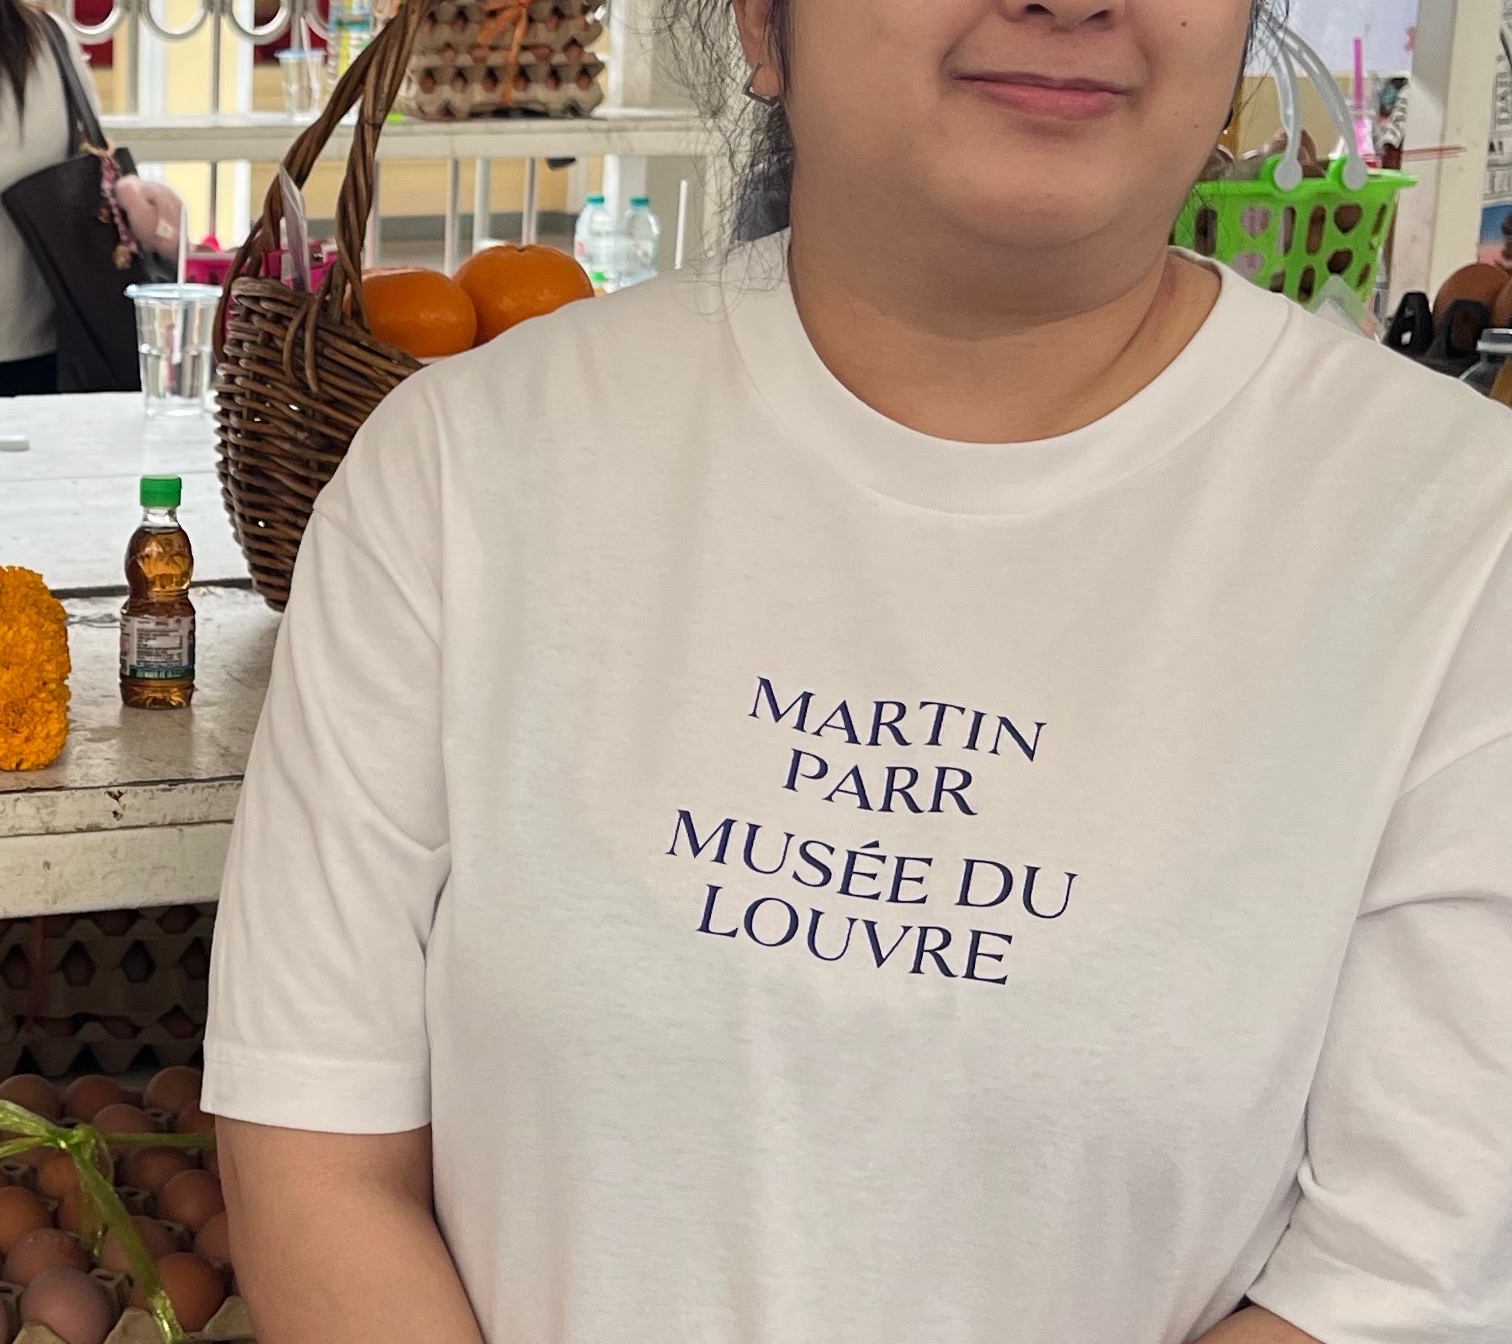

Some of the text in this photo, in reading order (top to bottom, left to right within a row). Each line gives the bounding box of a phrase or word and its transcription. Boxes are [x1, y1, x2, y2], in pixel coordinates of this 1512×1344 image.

[748, 676, 1046, 762] MARTIN
[783, 748, 978, 816] PARR
[666, 809, 1078, 919] MUSÉE DU
[696, 885, 1013, 985] LOUVRE
